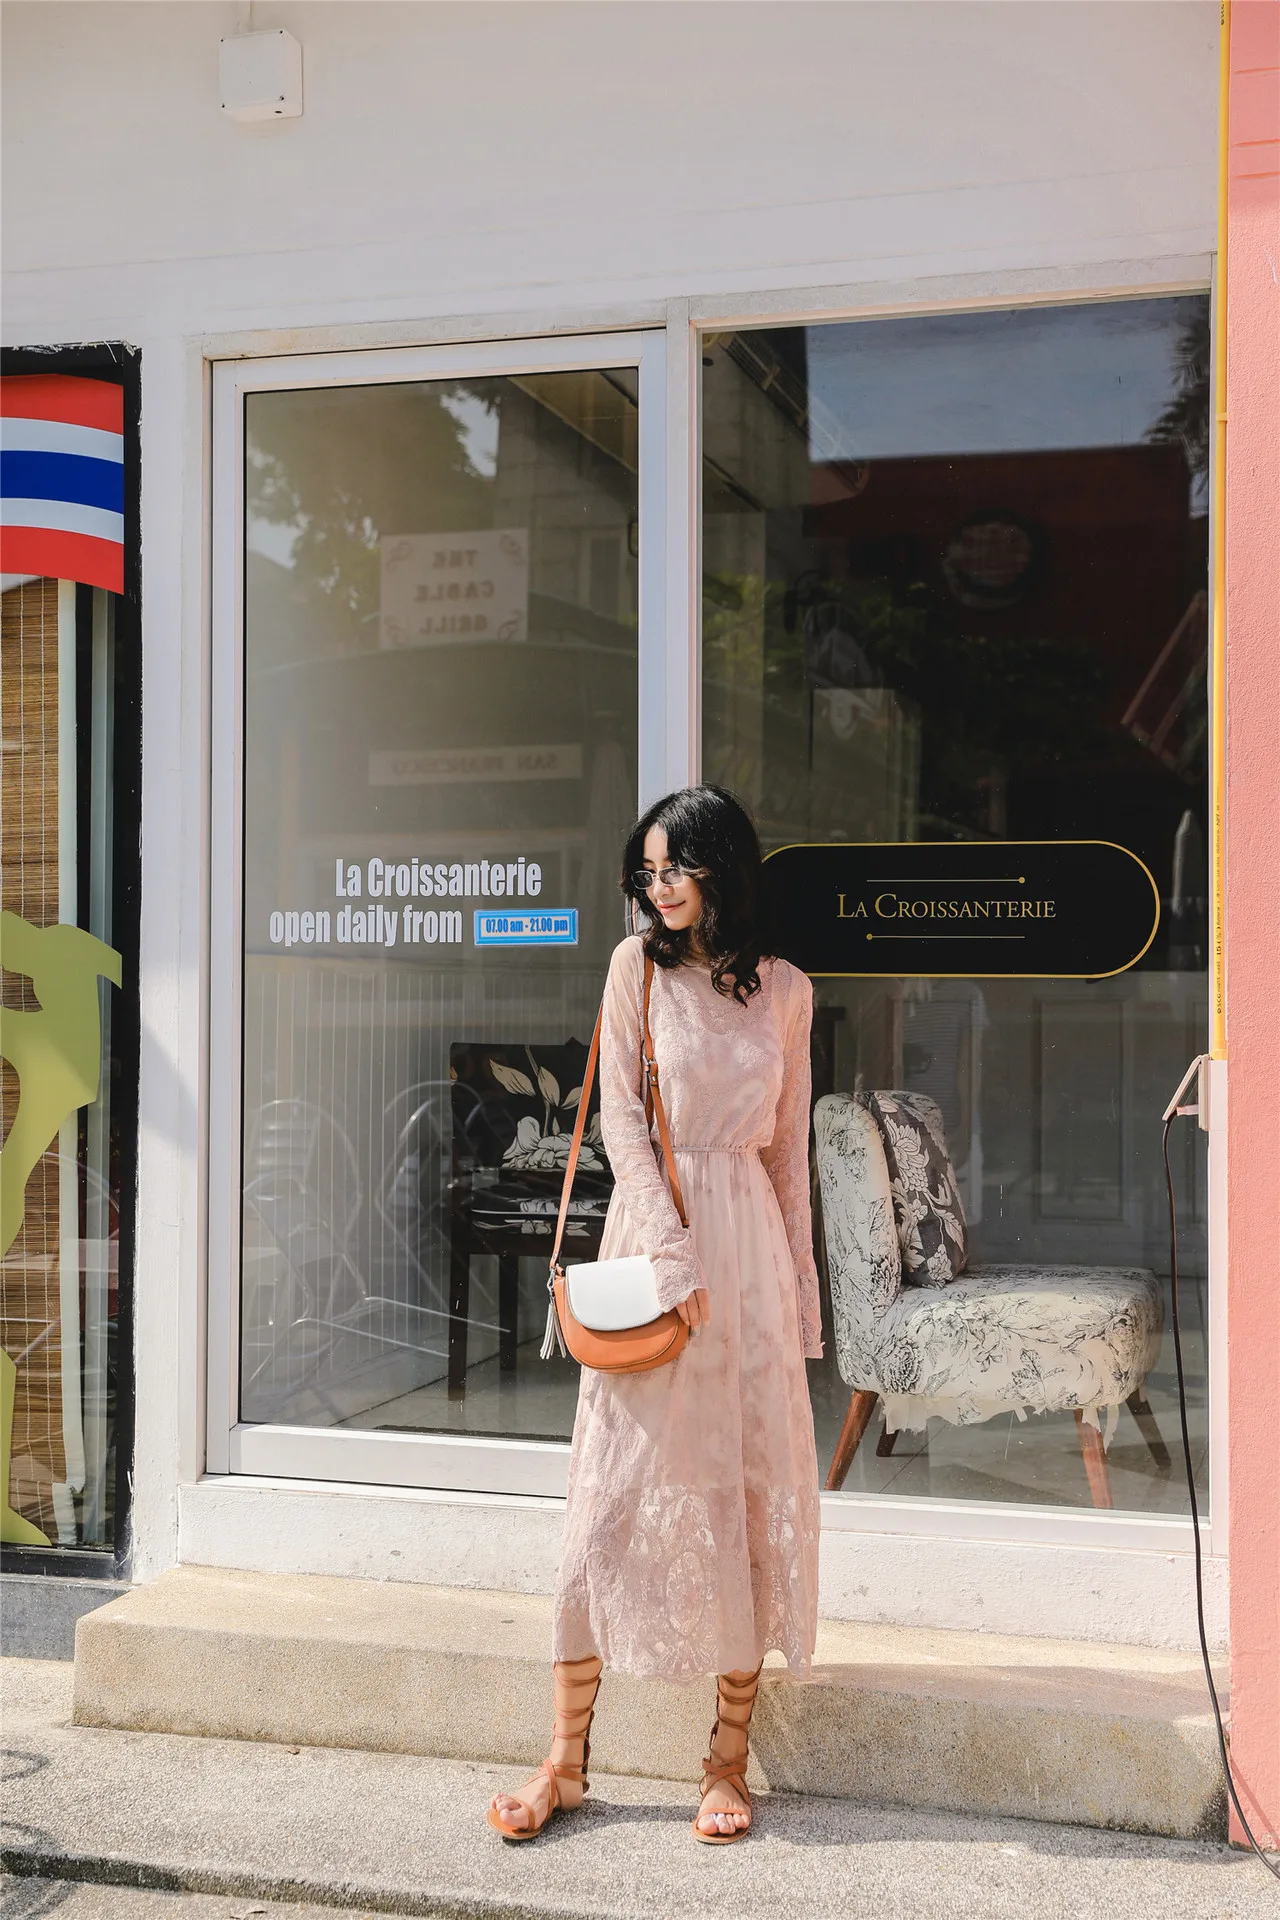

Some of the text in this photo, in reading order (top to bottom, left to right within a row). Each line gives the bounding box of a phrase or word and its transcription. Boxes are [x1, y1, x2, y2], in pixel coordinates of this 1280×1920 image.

[335, 857, 541, 897] La Croissanterie
[269, 910, 330, 946] open
[336, 905, 398, 947] daily
[403, 905, 463, 943] from
[486, 918, 508, 933] 07.00
[510, 920, 523, 932] am
[530, 917, 552, 932] 21.00
[554, 919, 568, 933] pm
